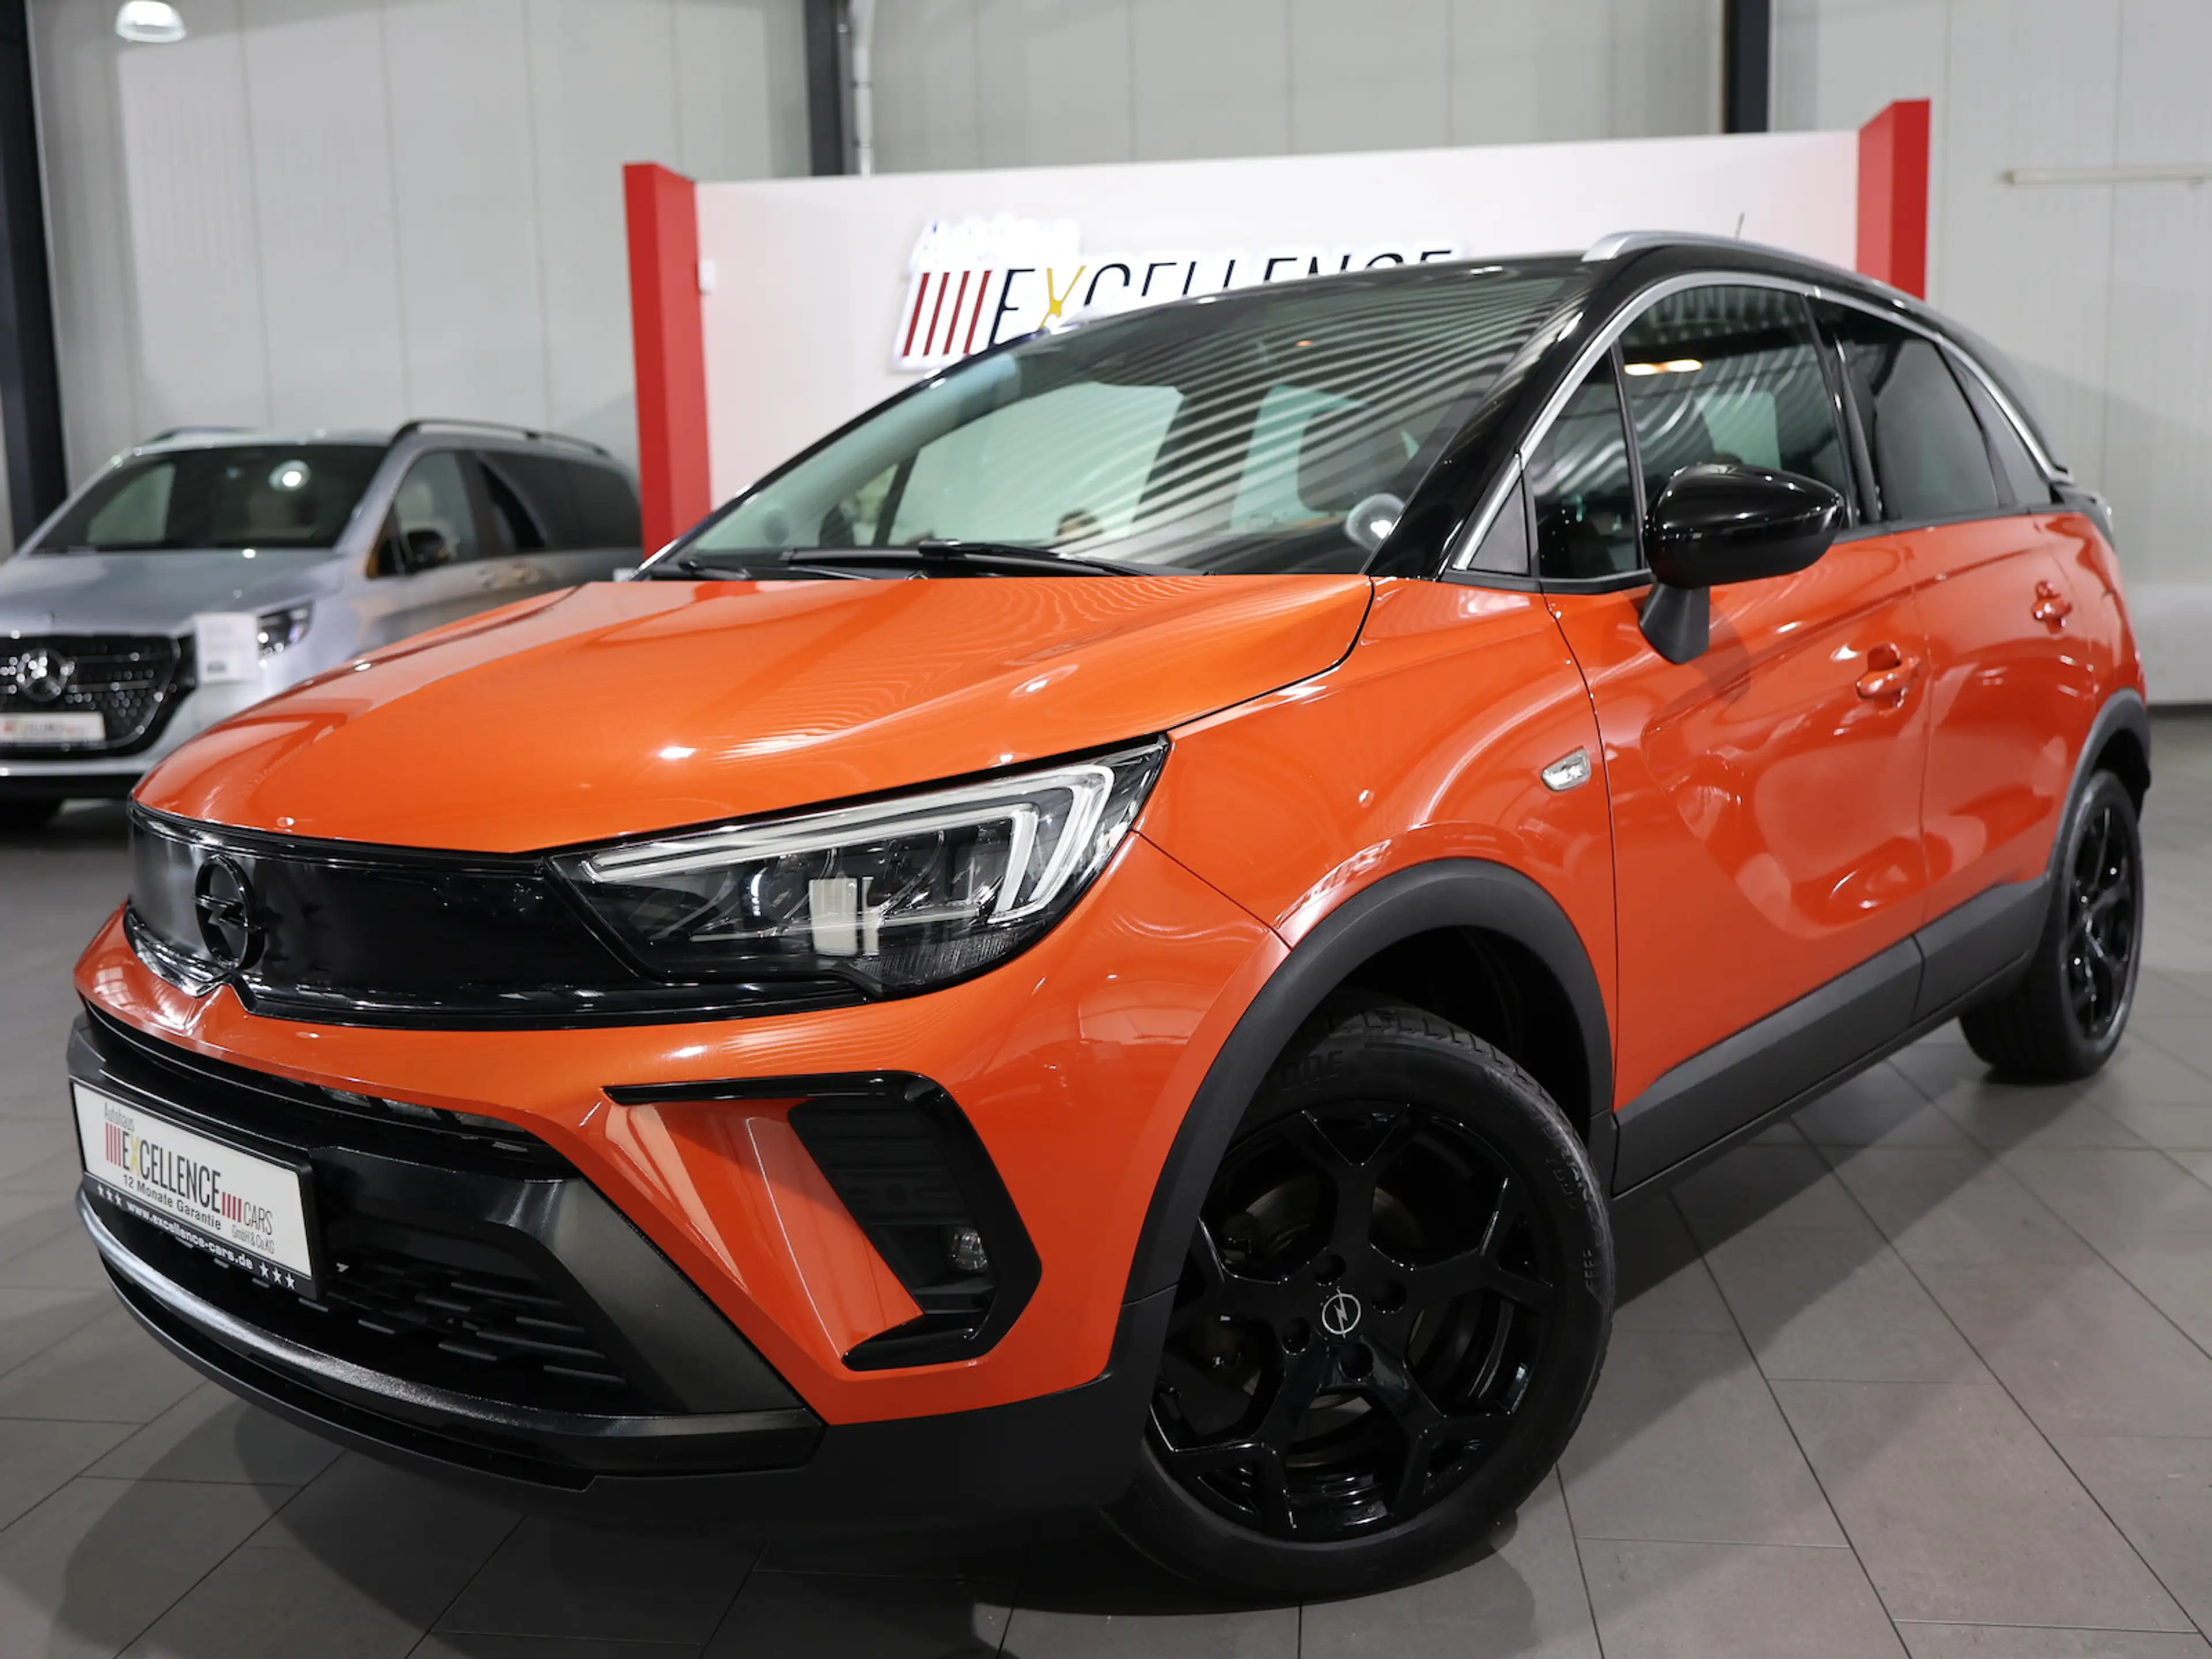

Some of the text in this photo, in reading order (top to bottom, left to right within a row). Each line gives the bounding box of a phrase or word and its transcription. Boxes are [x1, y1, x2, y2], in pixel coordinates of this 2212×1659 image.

[104, 1103, 134, 1132] Autohaus
[122, 1131, 273, 1236] EXCELLENCE CARS
[123, 1174, 221, 1230] 12 Monate Garantie
[126, 1201, 253, 1270] www.excellence-cars.de
